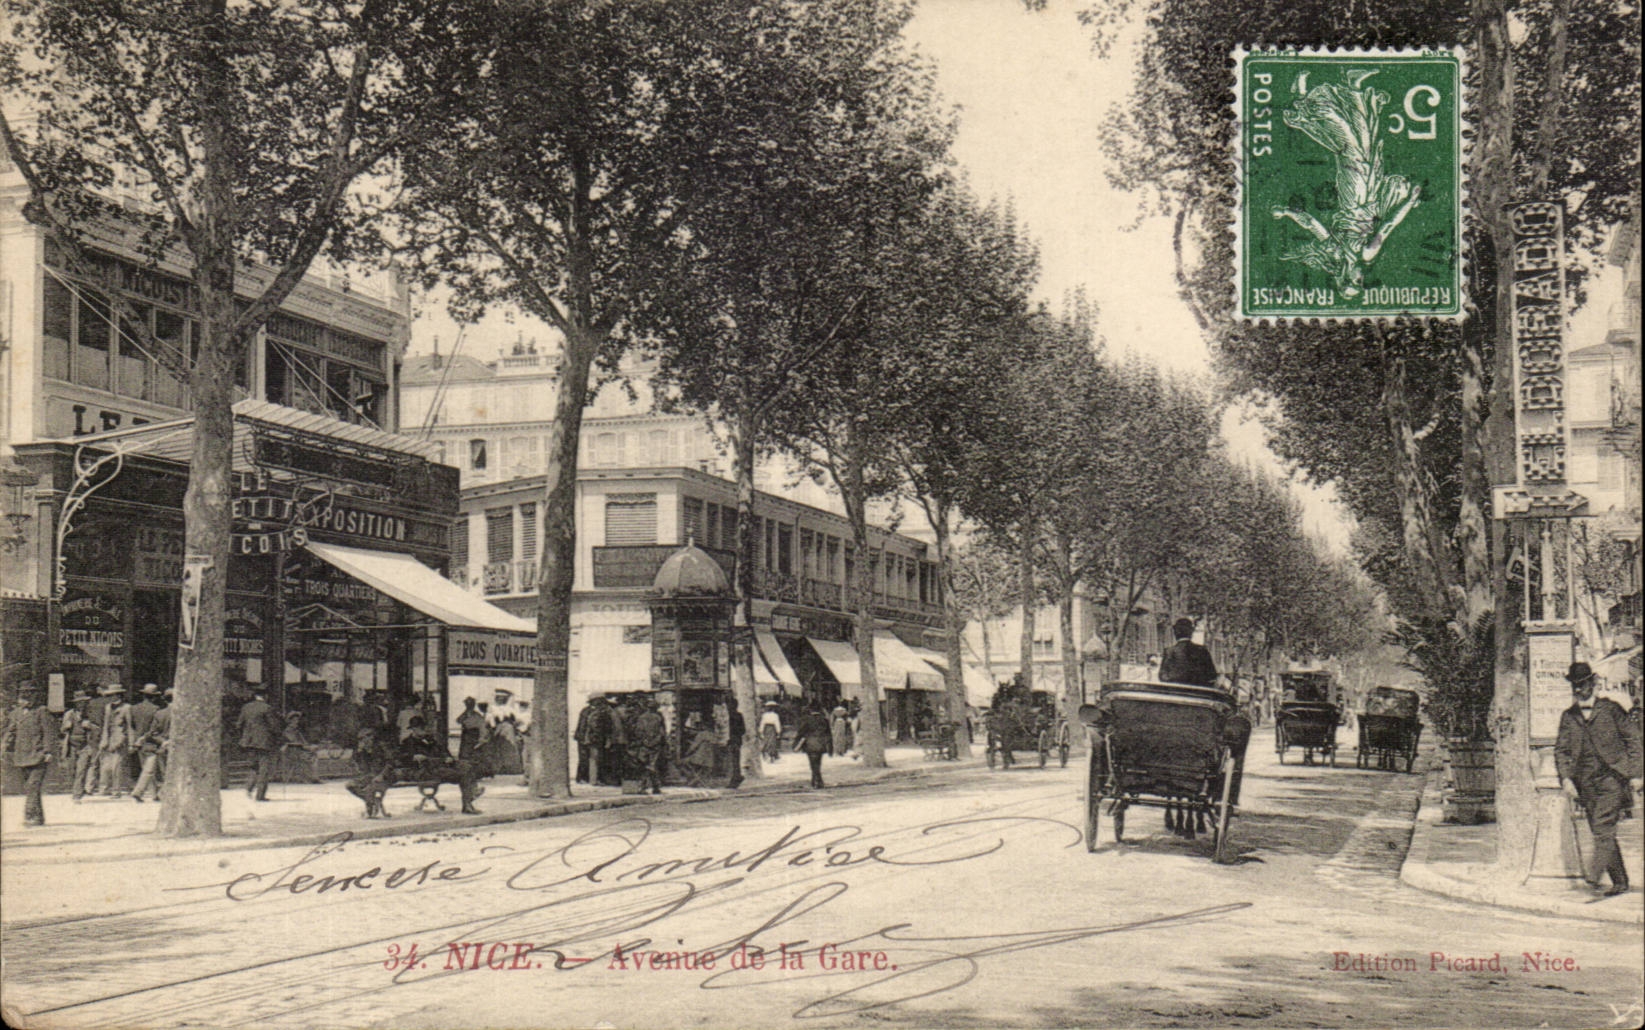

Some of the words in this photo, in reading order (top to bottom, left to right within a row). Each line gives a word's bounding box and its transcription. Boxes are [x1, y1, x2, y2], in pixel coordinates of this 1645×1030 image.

[1252, 73, 1273, 157] POSTES
[1252, 285, 1335, 306] FRANÇAISE
[240, 473, 267, 492] LE
[231, 498, 294, 519] ETIT
[228, 528, 306, 554] ICOIS
[455, 639, 487, 660] TROIS
